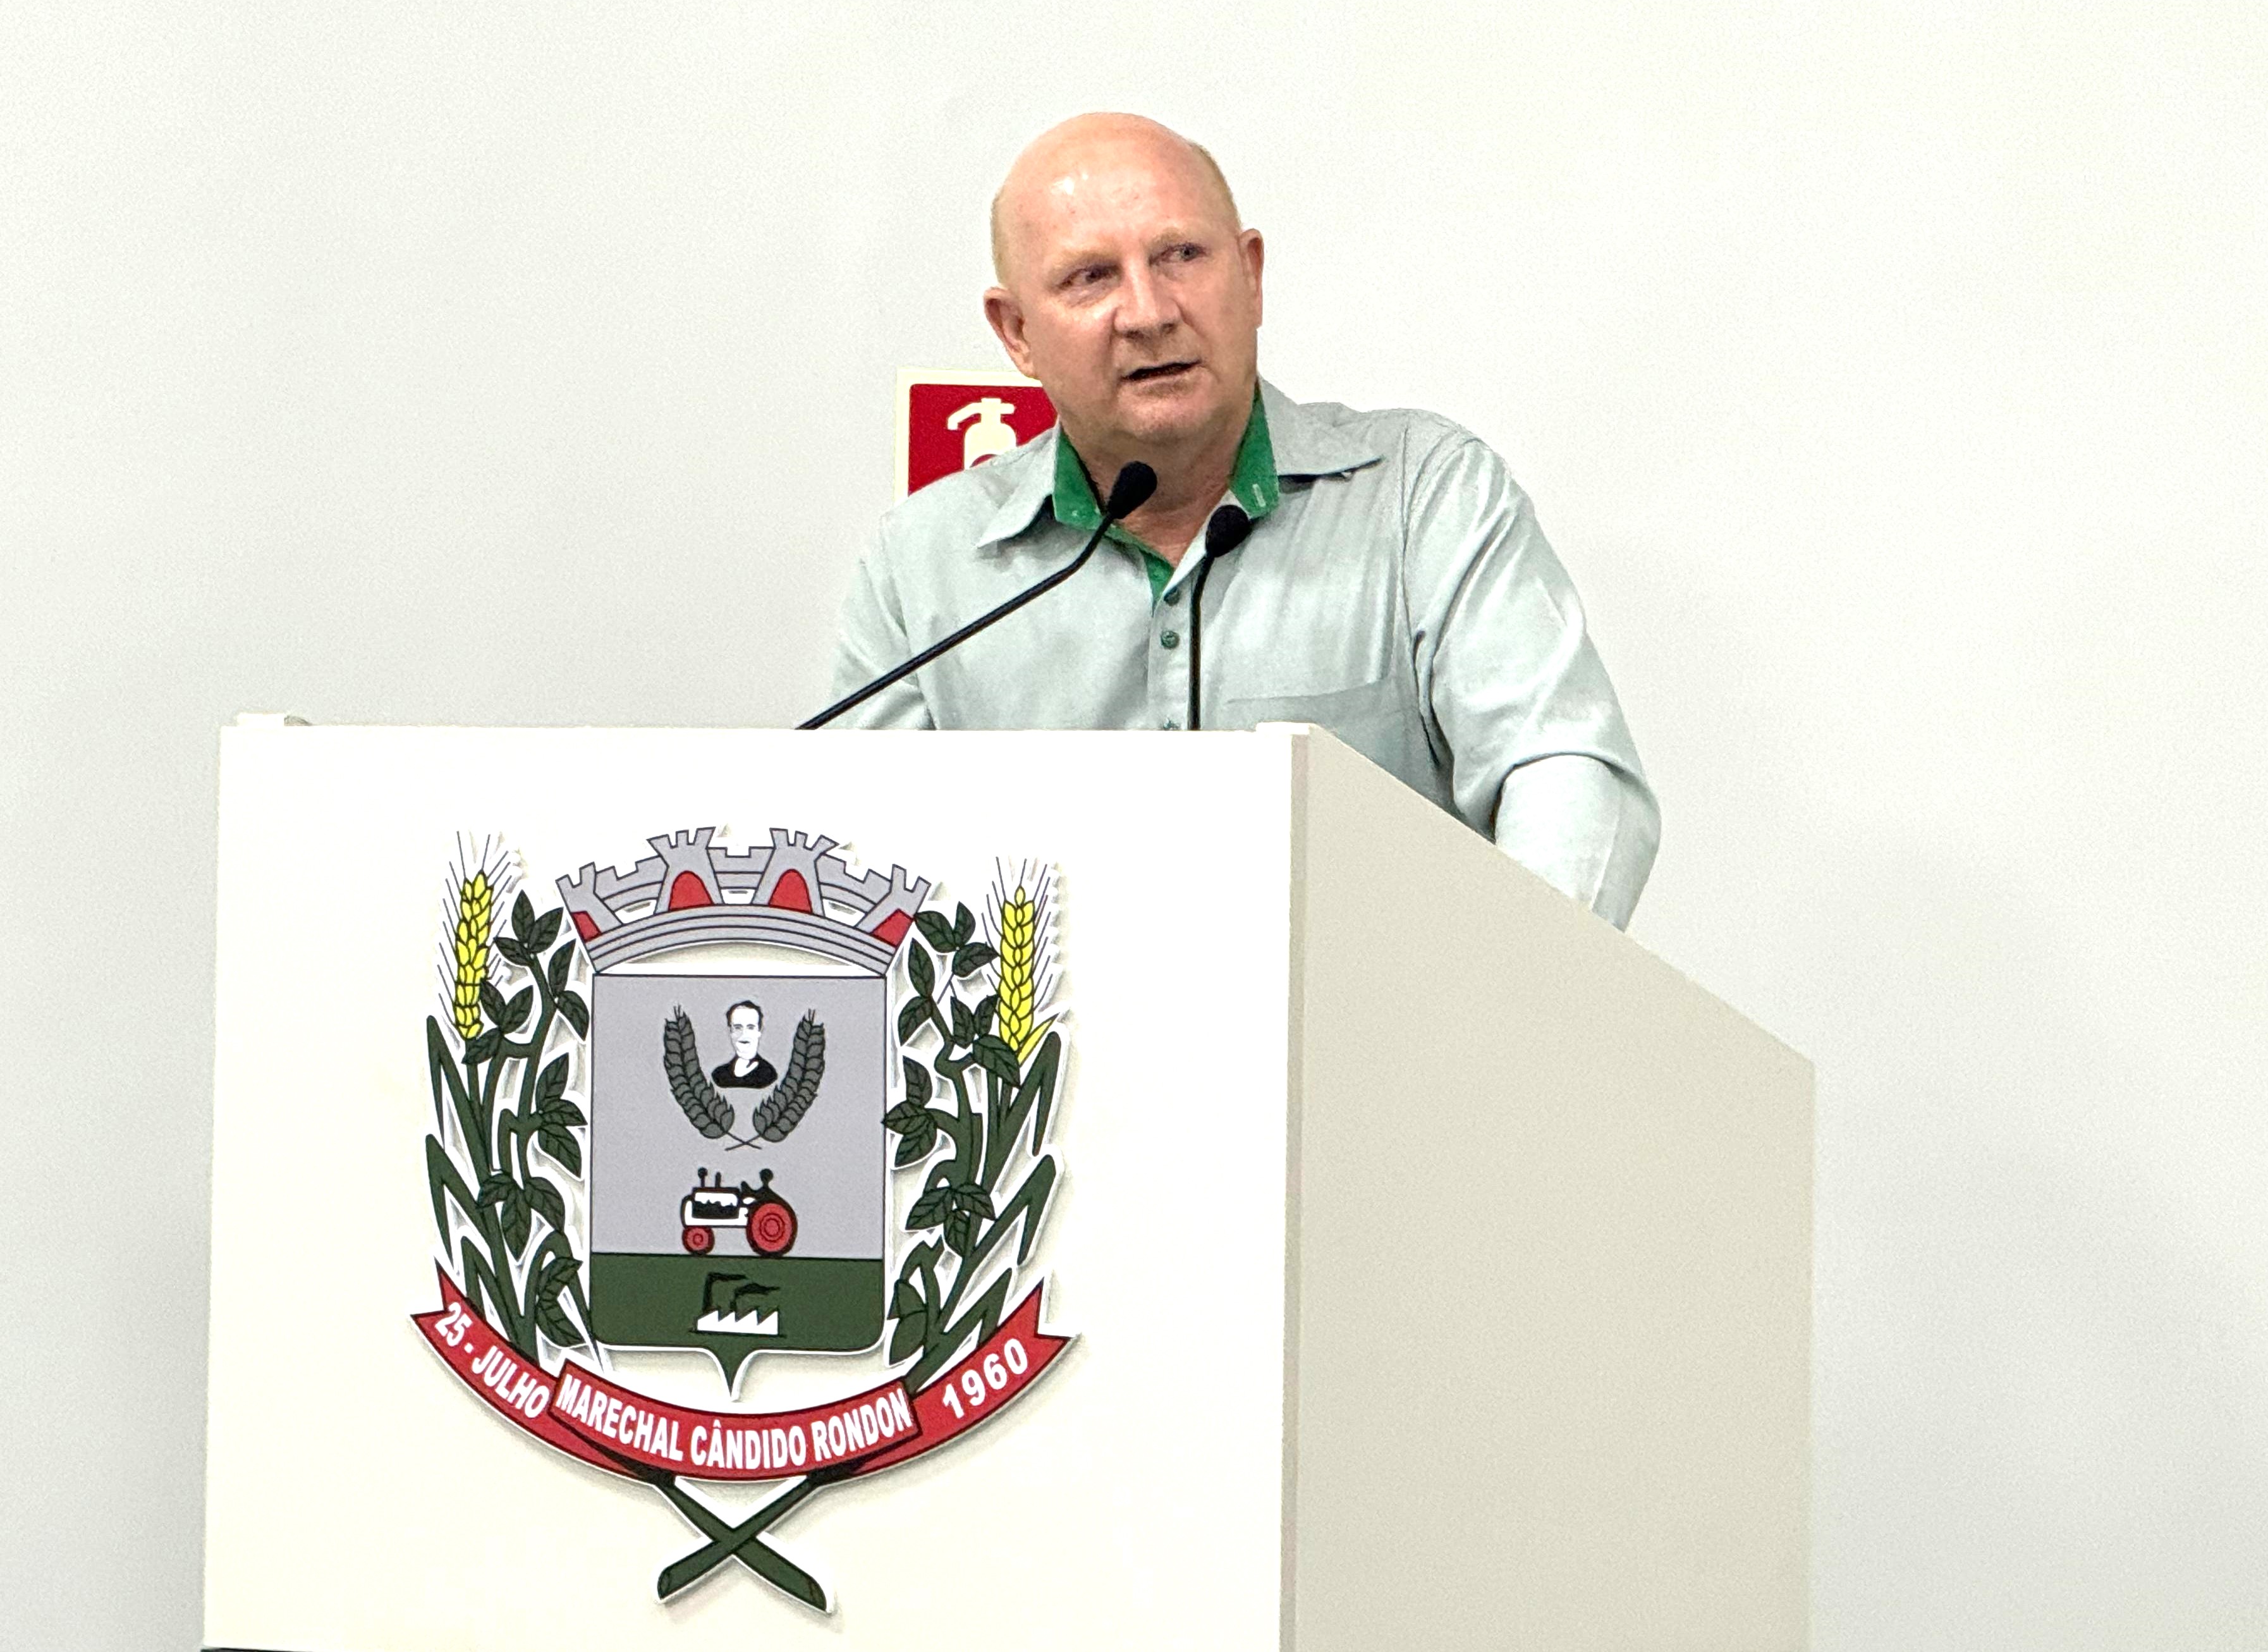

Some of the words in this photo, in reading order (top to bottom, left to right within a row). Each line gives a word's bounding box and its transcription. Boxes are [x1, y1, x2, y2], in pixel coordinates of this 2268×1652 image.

[434, 1302, 473, 1347] 25
[471, 1345, 550, 1418] JULHO
[942, 1338, 1028, 1419] 1960
[556, 1373, 683, 1461] MARECHAL
[690, 1418, 807, 1469] CÂNDIDO
[811, 1388, 913, 1461] RONDON
